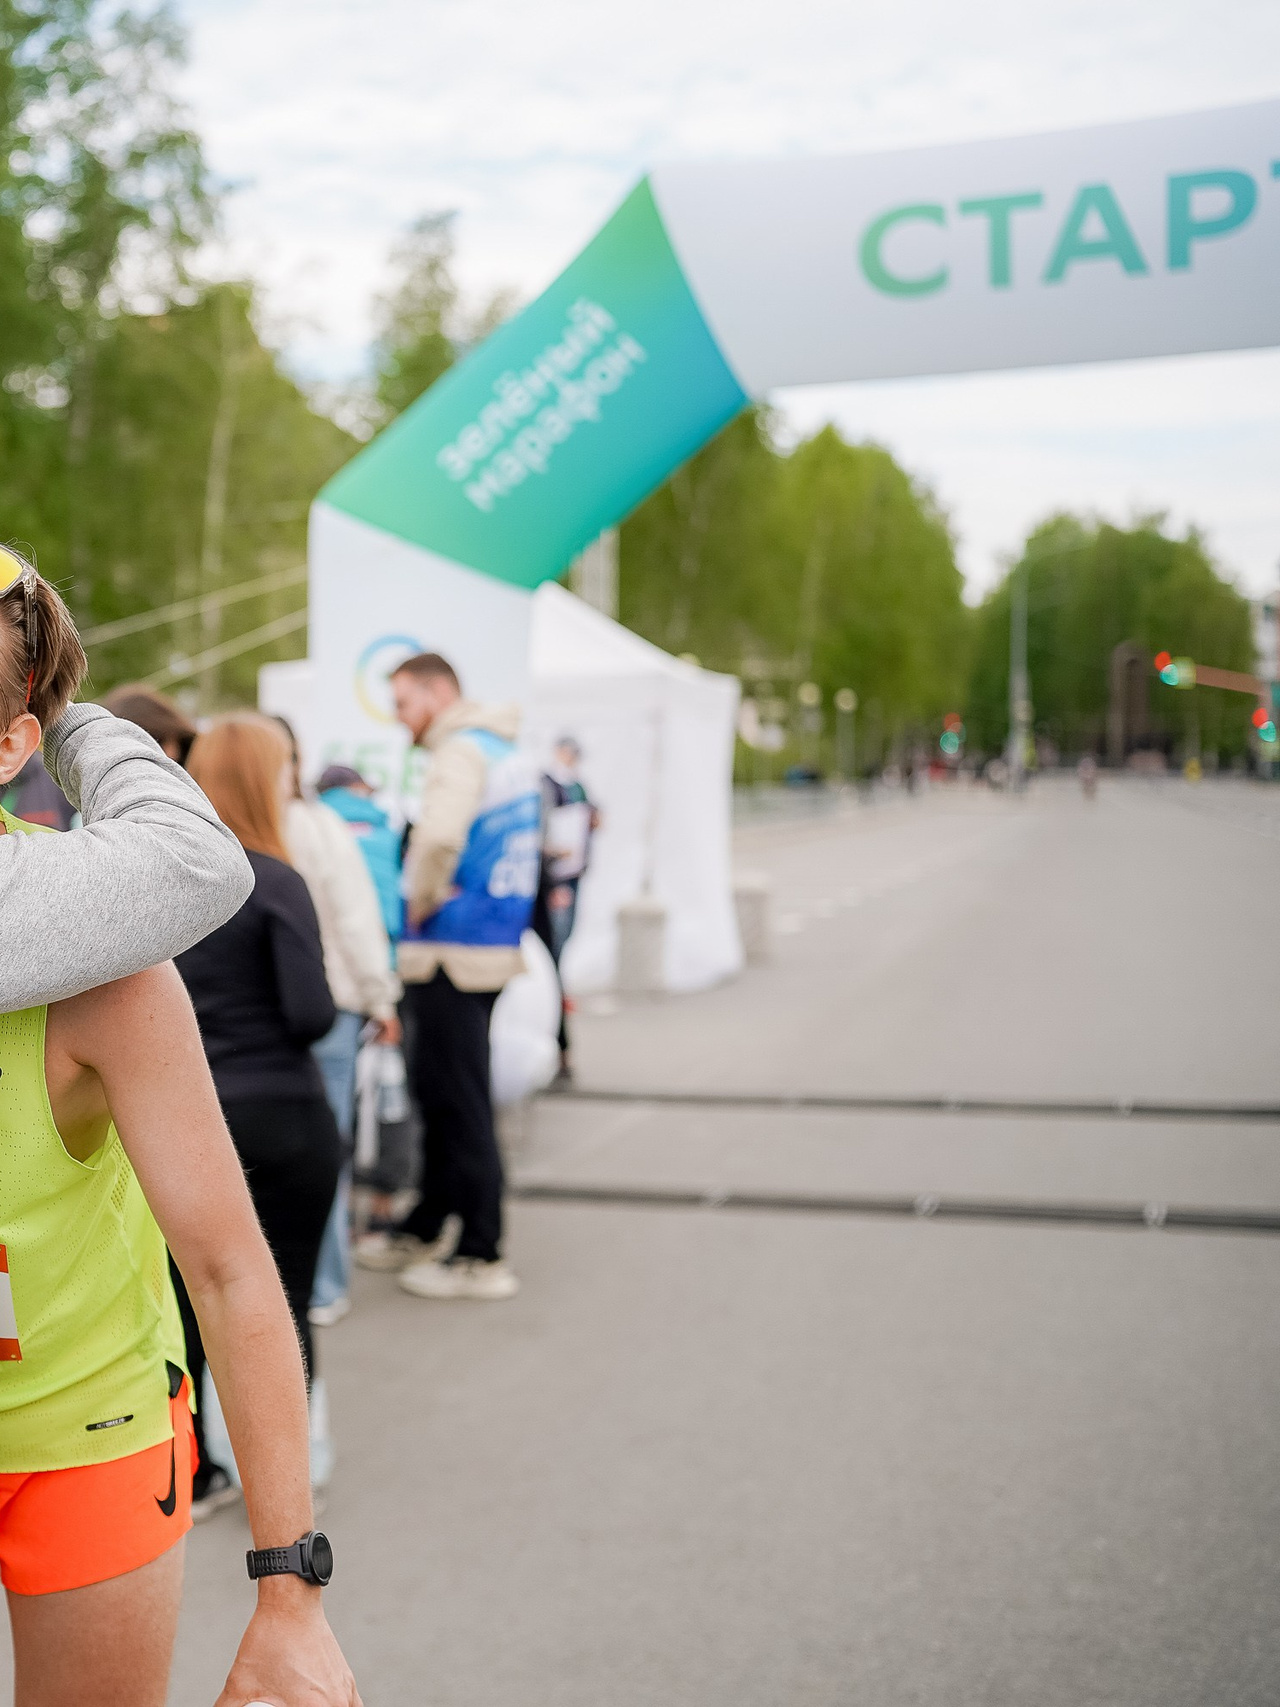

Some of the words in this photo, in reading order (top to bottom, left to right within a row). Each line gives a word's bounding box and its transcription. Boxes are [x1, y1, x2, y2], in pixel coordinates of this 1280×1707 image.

[856, 158, 1280, 300] СТАР
[436, 299, 616, 482] зелёный
[463, 332, 647, 513] марафон
